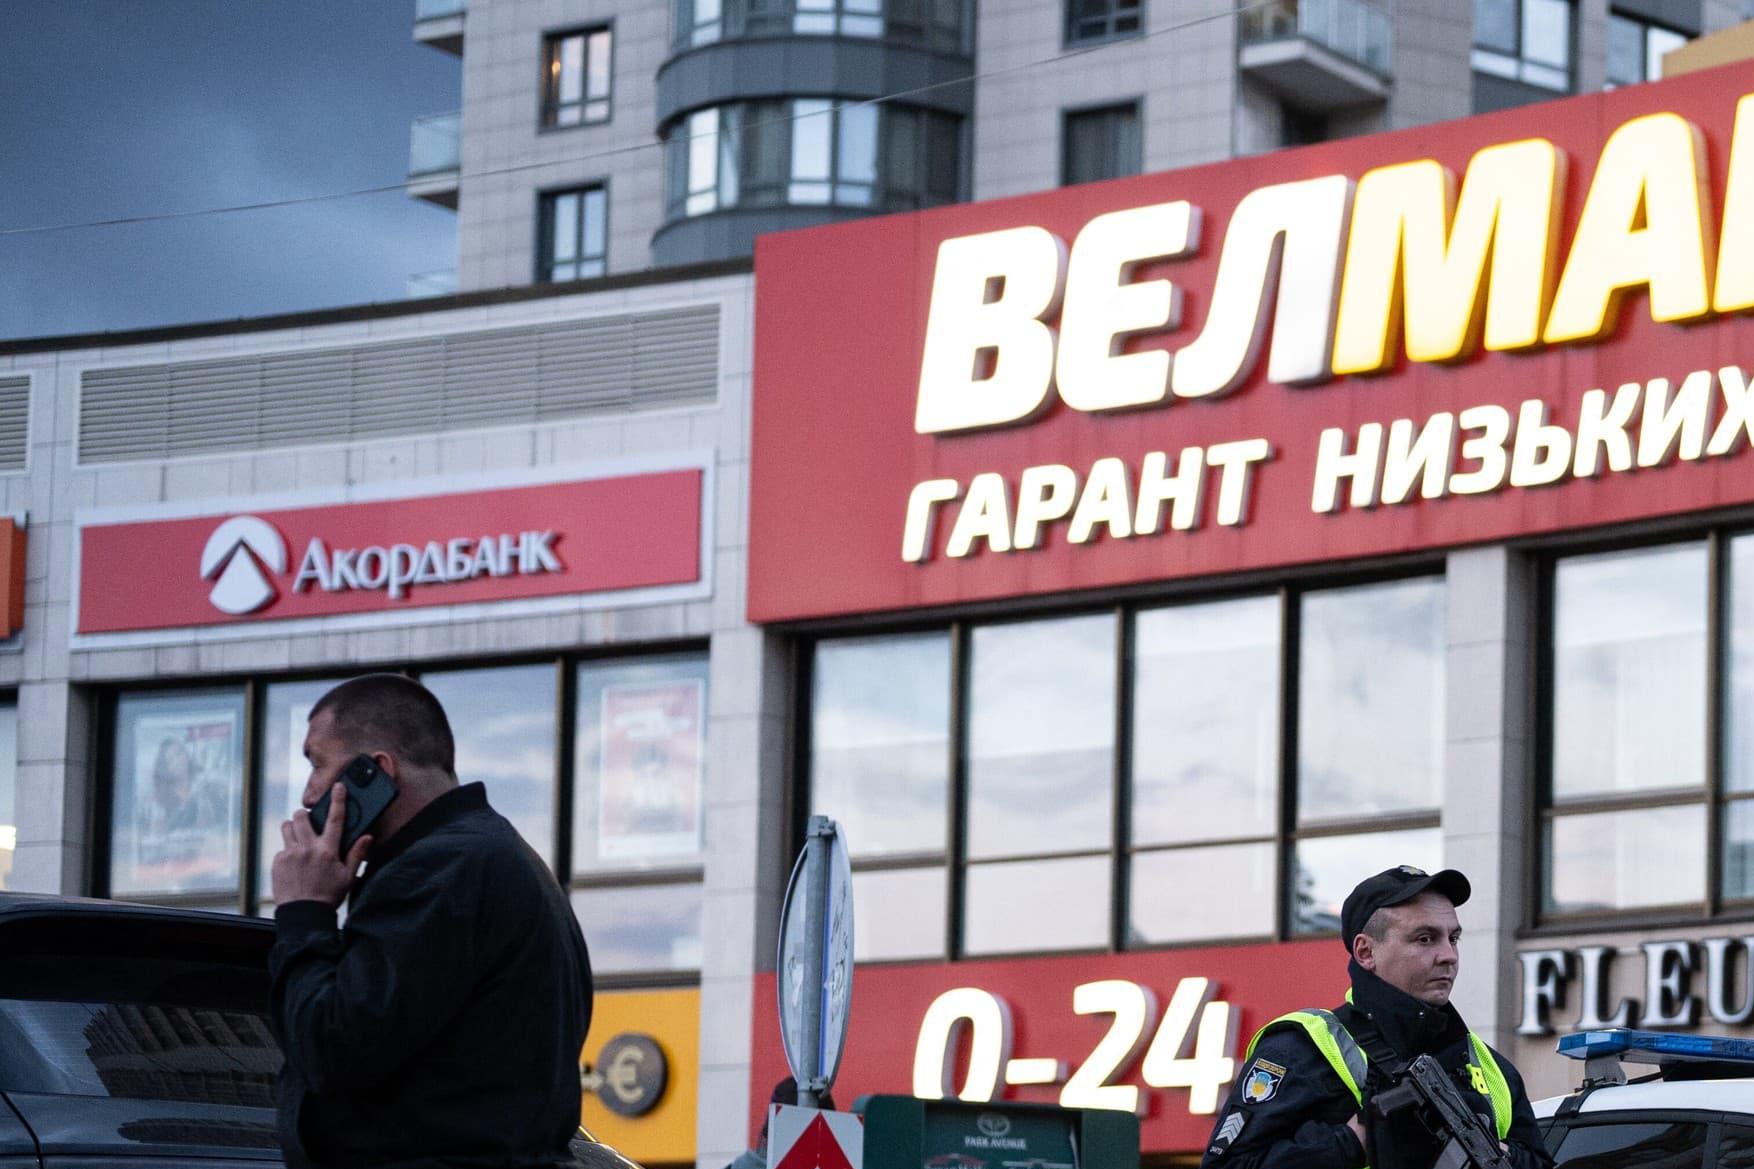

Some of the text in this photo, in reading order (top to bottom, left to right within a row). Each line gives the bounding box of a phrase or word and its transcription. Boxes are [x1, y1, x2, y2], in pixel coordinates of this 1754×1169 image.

[902, 437, 1272, 563] ГАРАНТ
[913, 977, 1238, 1115] 0-24
[964, 1135, 1026, 1149] PARK AVENUE
